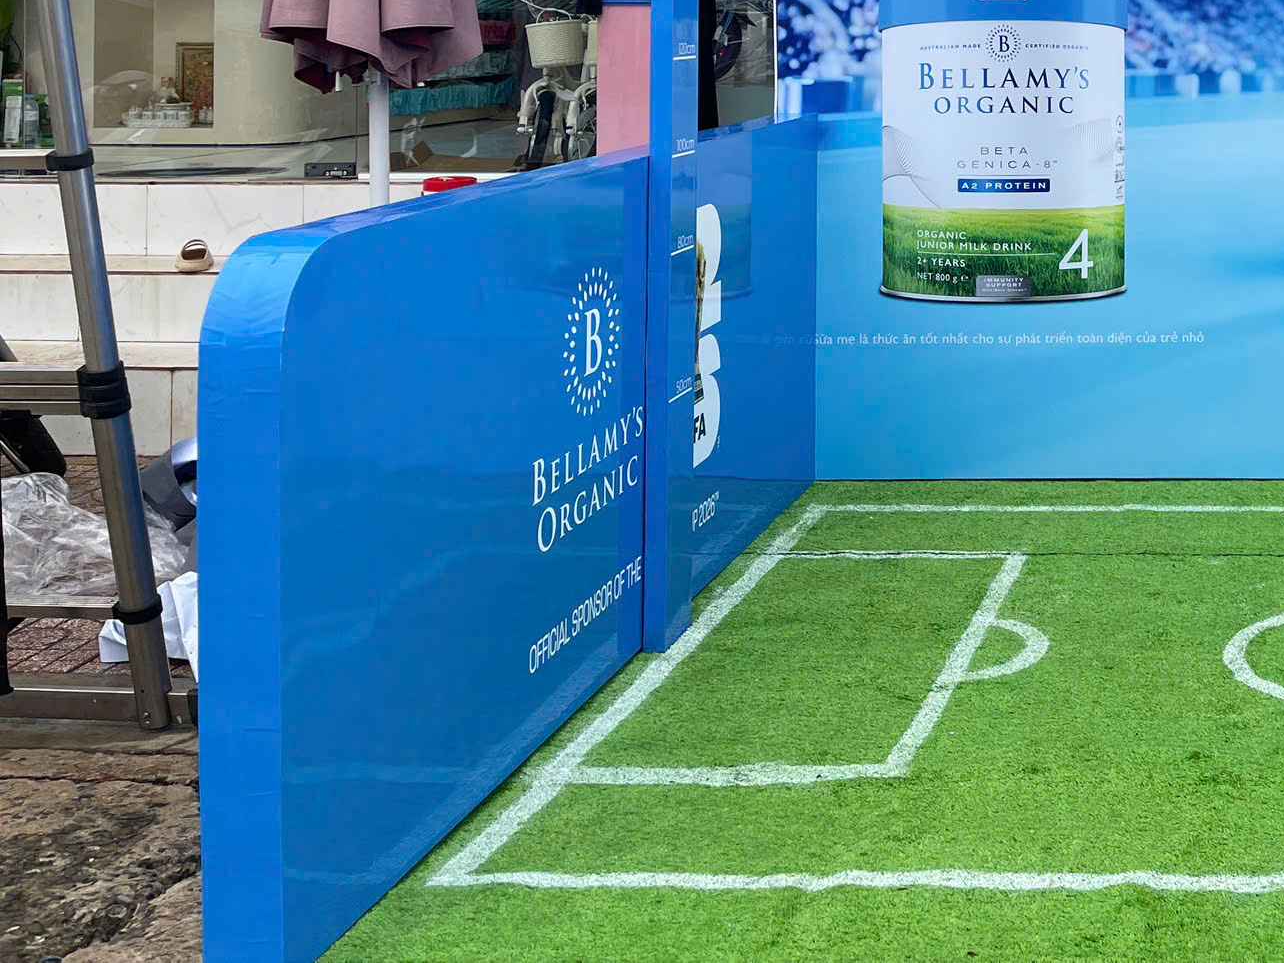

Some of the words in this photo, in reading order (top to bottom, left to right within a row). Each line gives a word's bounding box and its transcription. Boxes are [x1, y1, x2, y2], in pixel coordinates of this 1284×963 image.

[999, 35, 1009, 52] B
[919, 63, 1089, 89] BELLAMY'S
[934, 96, 1073, 114] ORGANIC
[981, 147, 1028, 155] BETA
[677, 234, 694, 249] 80cm
[917, 230, 966, 240] ORGANIC
[917, 240, 954, 251] JUNIOR
[960, 242, 988, 251] MILK
[993, 242, 1032, 251] DRINK
[1058, 228, 1094, 279] 4
[917, 257, 927, 265] 2+
[931, 257, 966, 268] YEARS
[917, 272, 932, 280] NET
[935, 273, 950, 281] 800
[583, 308, 604, 377] B
[837, 335, 856, 347] mẹ
[859, 333, 869, 345] là
[873, 332, 899, 345] thức
[903, 334, 917, 345] ăn
[920, 331, 938, 344] tốt
[942, 332, 969, 344] nhất
[973, 333, 994, 344] cho
[1016, 332, 1041, 346] phát
[1045, 330, 1073, 344] triển
[1077, 332, 1104, 344] toàn
[1107, 332, 1132, 346] diện
[1136, 330, 1156, 343] của
[1160, 330, 1178, 343] trẻ
[1182, 330, 1205, 343] nhỏ
[676, 376, 692, 394] 50cm
[537, 455, 639, 553] ORGANIC
[529, 617, 571, 674] OFFICIAL
[571, 580, 613, 637] SPONSOR
[614, 569, 625, 600] OF
[626, 555, 642, 589] THE
